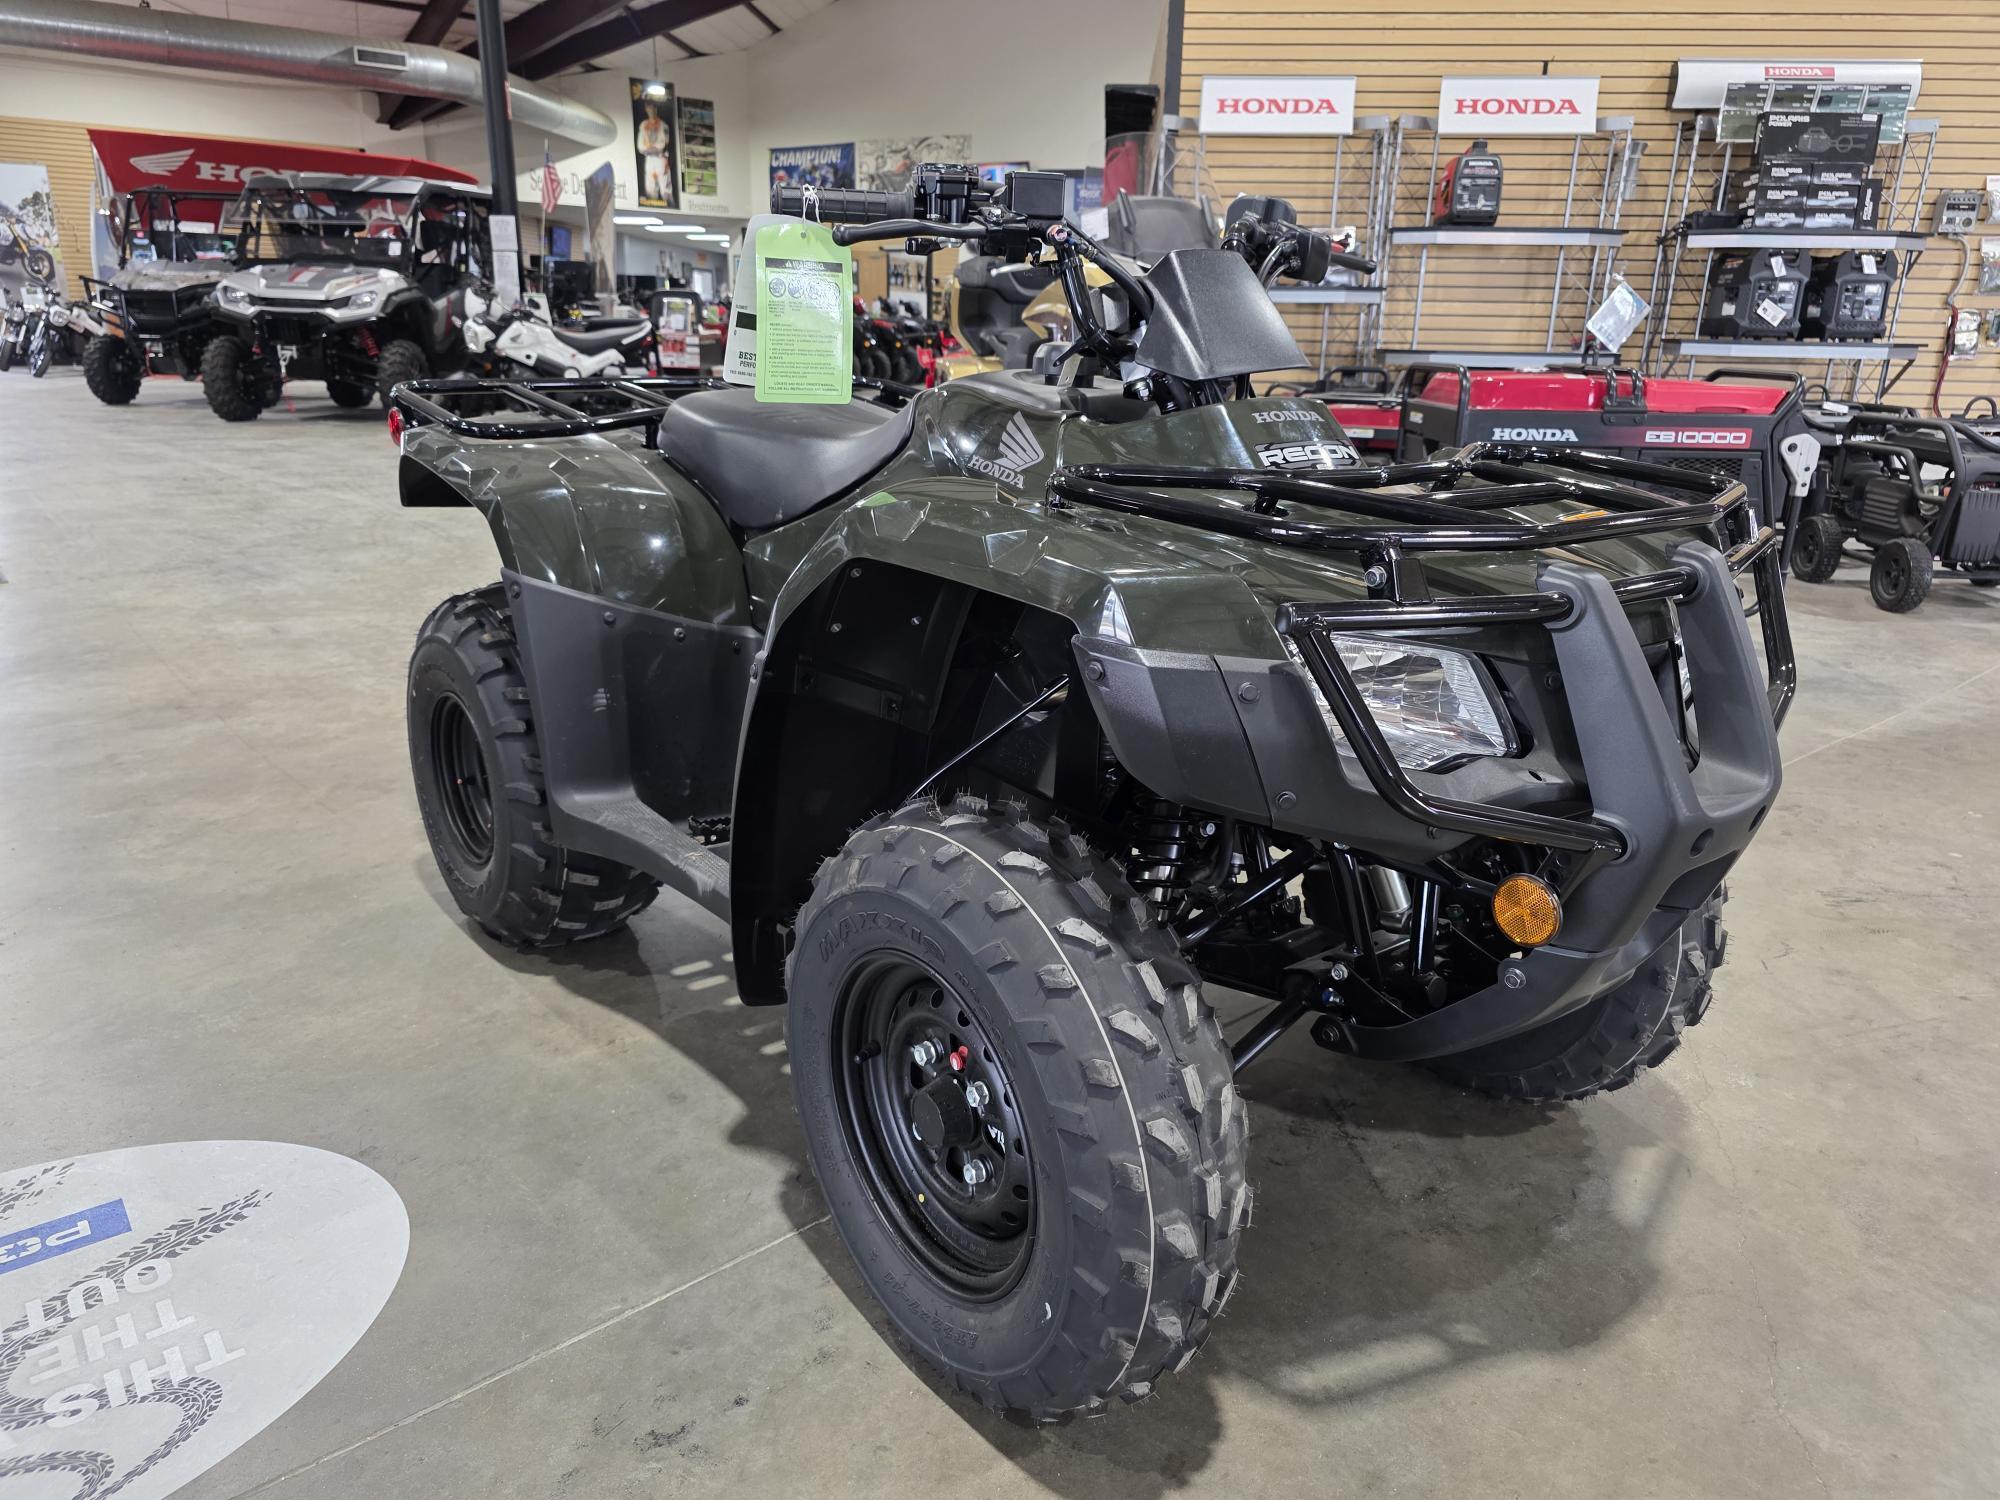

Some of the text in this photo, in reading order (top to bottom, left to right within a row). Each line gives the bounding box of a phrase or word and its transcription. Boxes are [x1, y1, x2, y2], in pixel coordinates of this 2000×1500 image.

[1768, 67, 1823, 76] HONDA
[1216, 98, 1339, 114] HONDA
[1455, 98, 1581, 115] HONDA
[1769, 115, 1810, 123] POLARIS
[771, 148, 841, 166] CHAMPION!
[1251, 411, 1326, 424] HONDA
[1492, 428, 1579, 442] HONDA
[1645, 430, 1747, 444] EB10000
[1257, 445, 1360, 467] RECON
[967, 454, 1024, 489] HONDA
[819, 911, 946, 964] MAXXIS
[29, 1298, 196, 1385] THE
[43, 1330, 247, 1429] THIS
